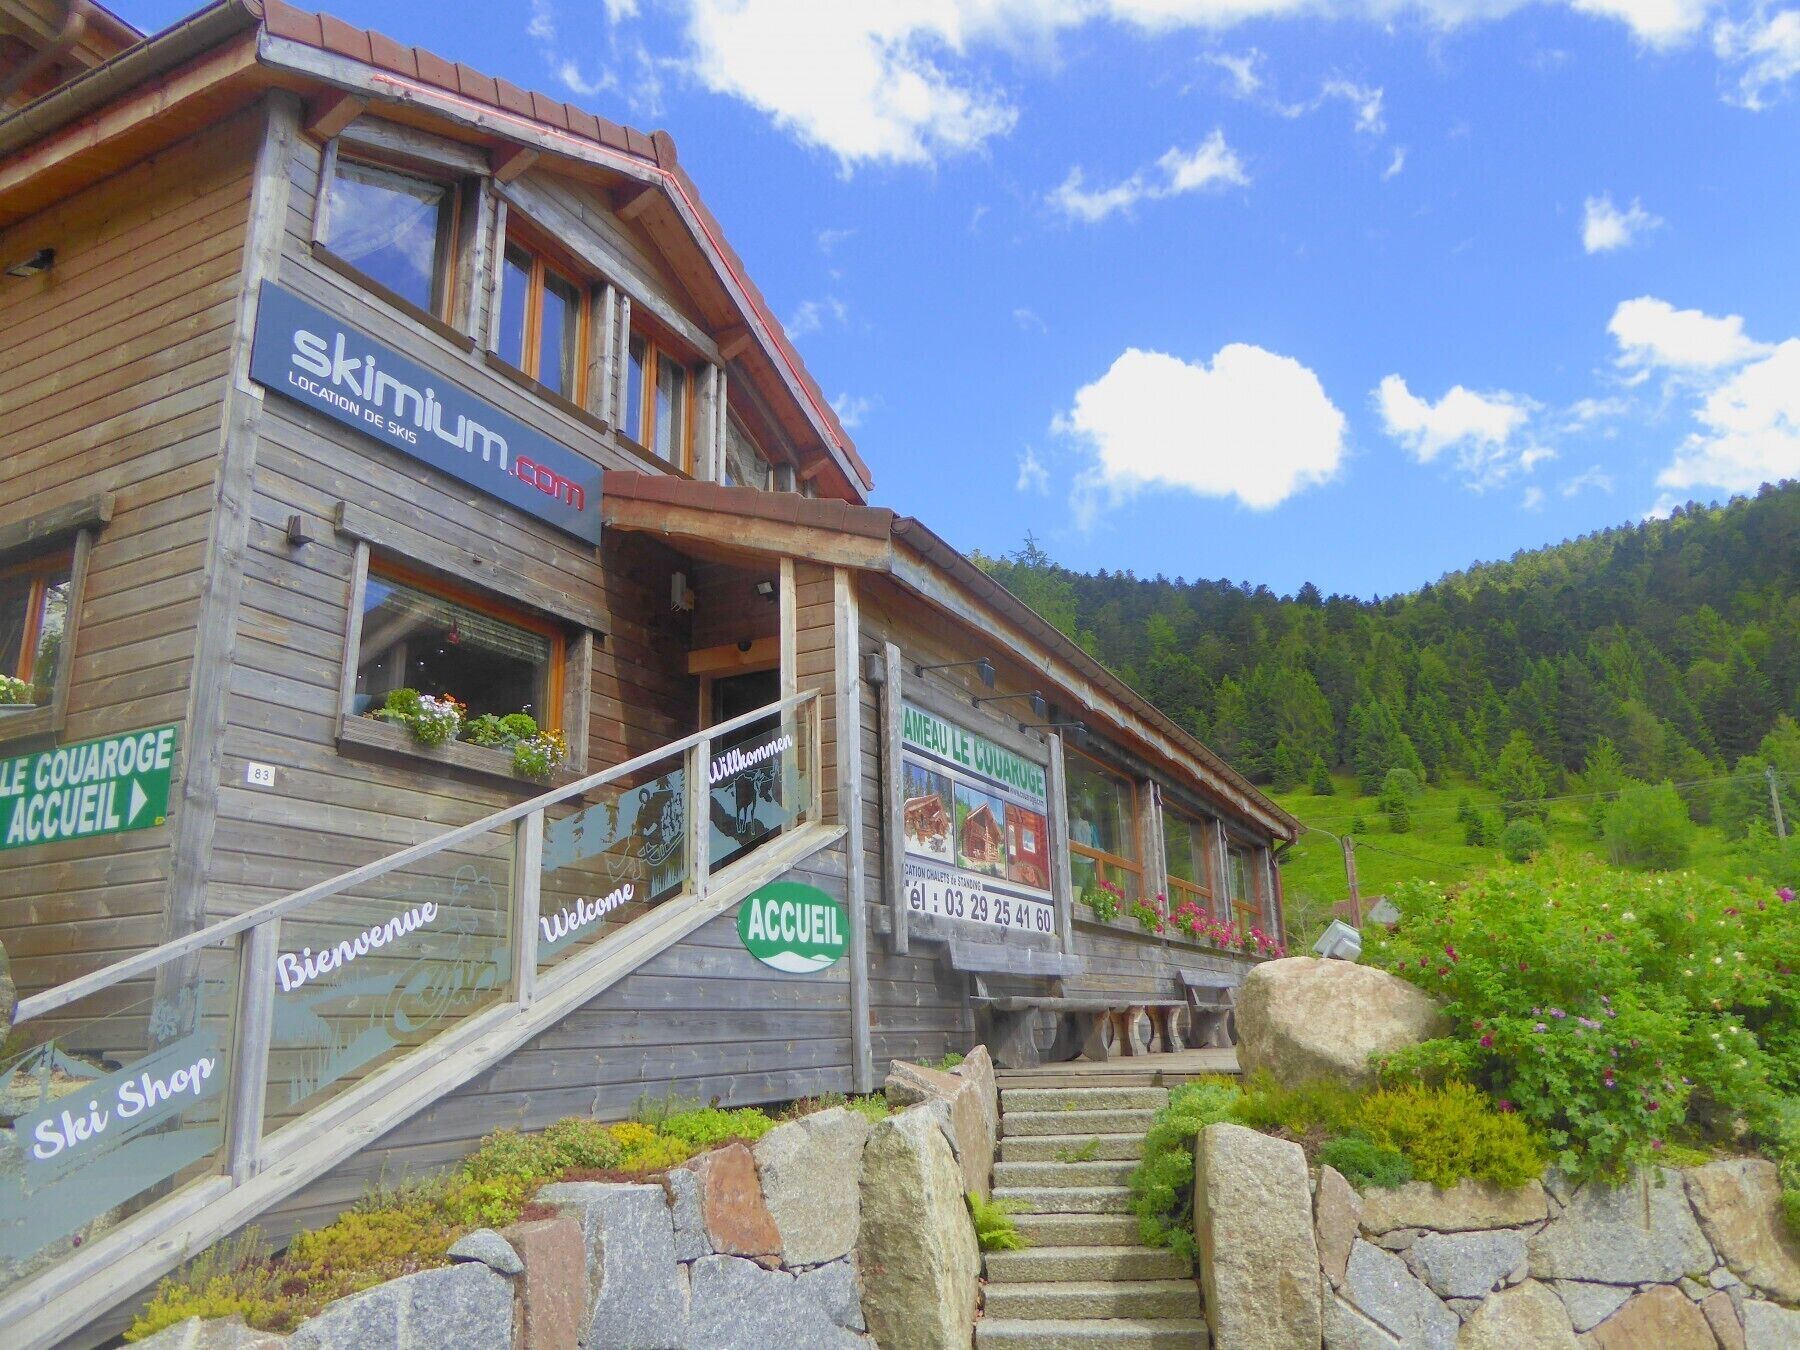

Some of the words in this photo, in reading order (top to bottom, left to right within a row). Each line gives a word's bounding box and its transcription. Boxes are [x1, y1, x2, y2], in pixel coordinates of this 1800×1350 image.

[288, 371, 360, 416] LOCATION
[364, 408, 383, 428] DE
[388, 420, 417, 444] SKIS
[292, 329, 585, 512] skimium.com
[0, 758, 28, 796] LE
[34, 728, 174, 791] COUAROGE
[254, 768, 269, 781] 83
[709, 733, 793, 784] Willkommen
[901, 706, 947, 755] AMEAU
[951, 726, 970, 766] LE
[974, 735, 1044, 797] COUAROGE
[7, 781, 120, 844] ACCUEIL
[904, 864, 926, 879] CATION
[927, 869, 950, 884] CHALETS
[951, 875, 957, 886] de
[958, 876, 981, 891] STANDING
[540, 883, 635, 944] Welcome
[748, 898, 843, 945] ACCUEIL
[945, 888, 964, 918] 03
[970, 893, 988, 922] 29
[994, 898, 1011, 926] 25
[1016, 903, 1030, 929] 41
[1036, 907, 1051, 933] 60
[277, 901, 439, 992] Bienvenue
[33, 1100, 109, 1159] Ski
[117, 1057, 215, 1118] Shop
